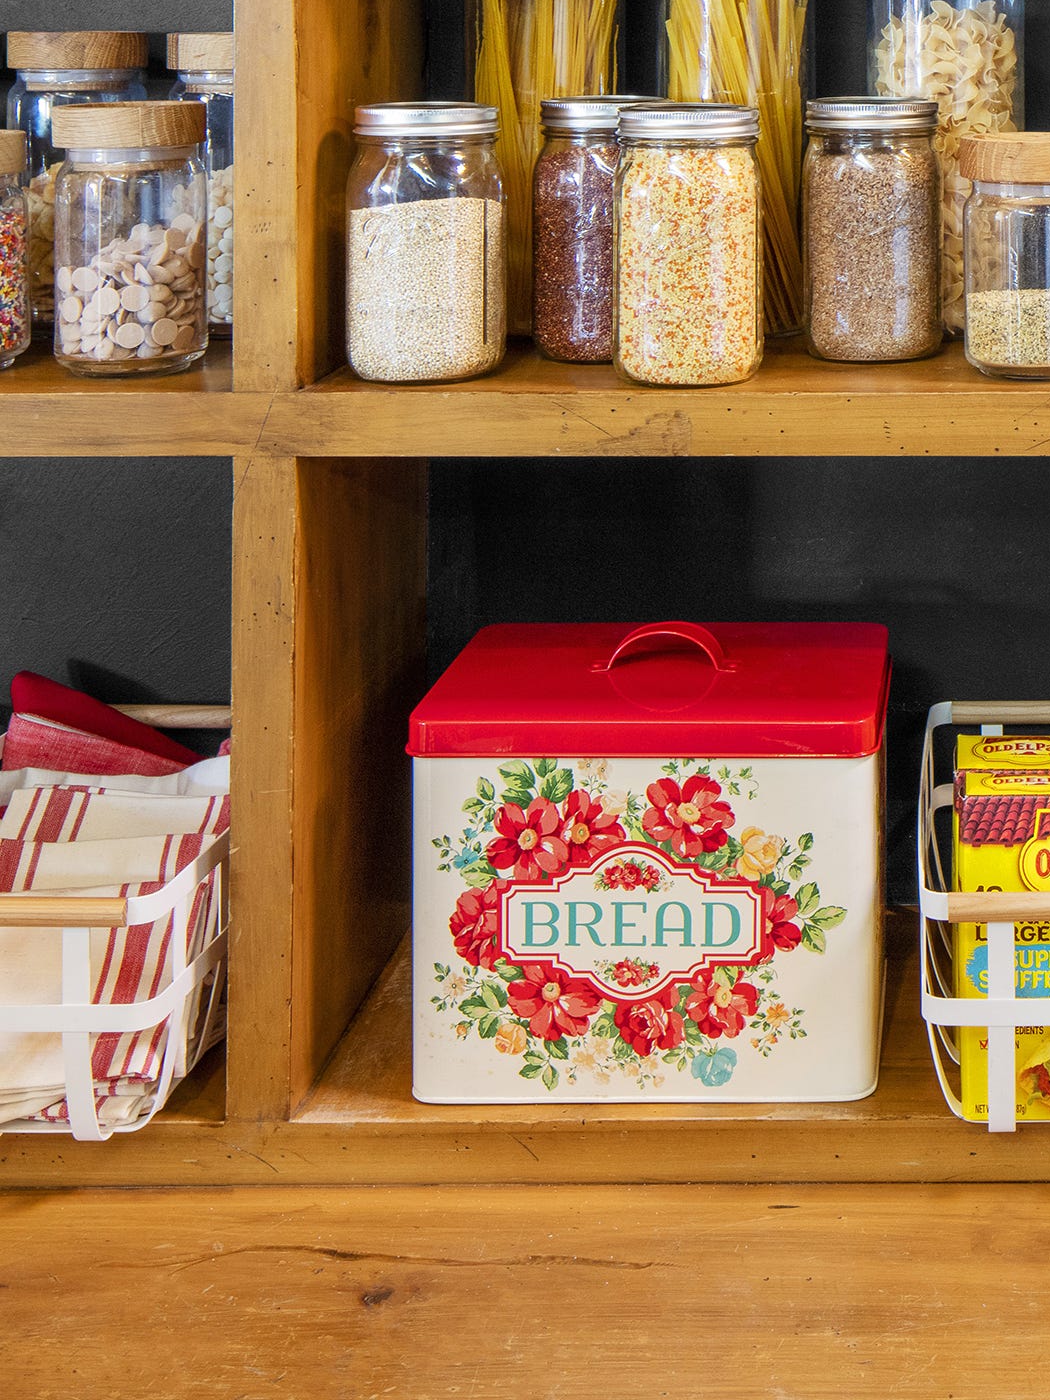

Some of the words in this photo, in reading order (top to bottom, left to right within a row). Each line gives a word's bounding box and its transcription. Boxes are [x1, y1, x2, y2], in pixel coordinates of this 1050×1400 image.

[983, 742, 1013, 754] OLD
[1014, 742, 1034, 751] EL
[992, 777, 1023, 785] OLD
[521, 900, 741, 947] BREAD
[975, 925, 1050, 942] LRGE
[1015, 1025, 1044, 1035] EDIENTS
[975, 1104, 986, 1113] NET
[1015, 1104, 1027, 1115] 87g)
